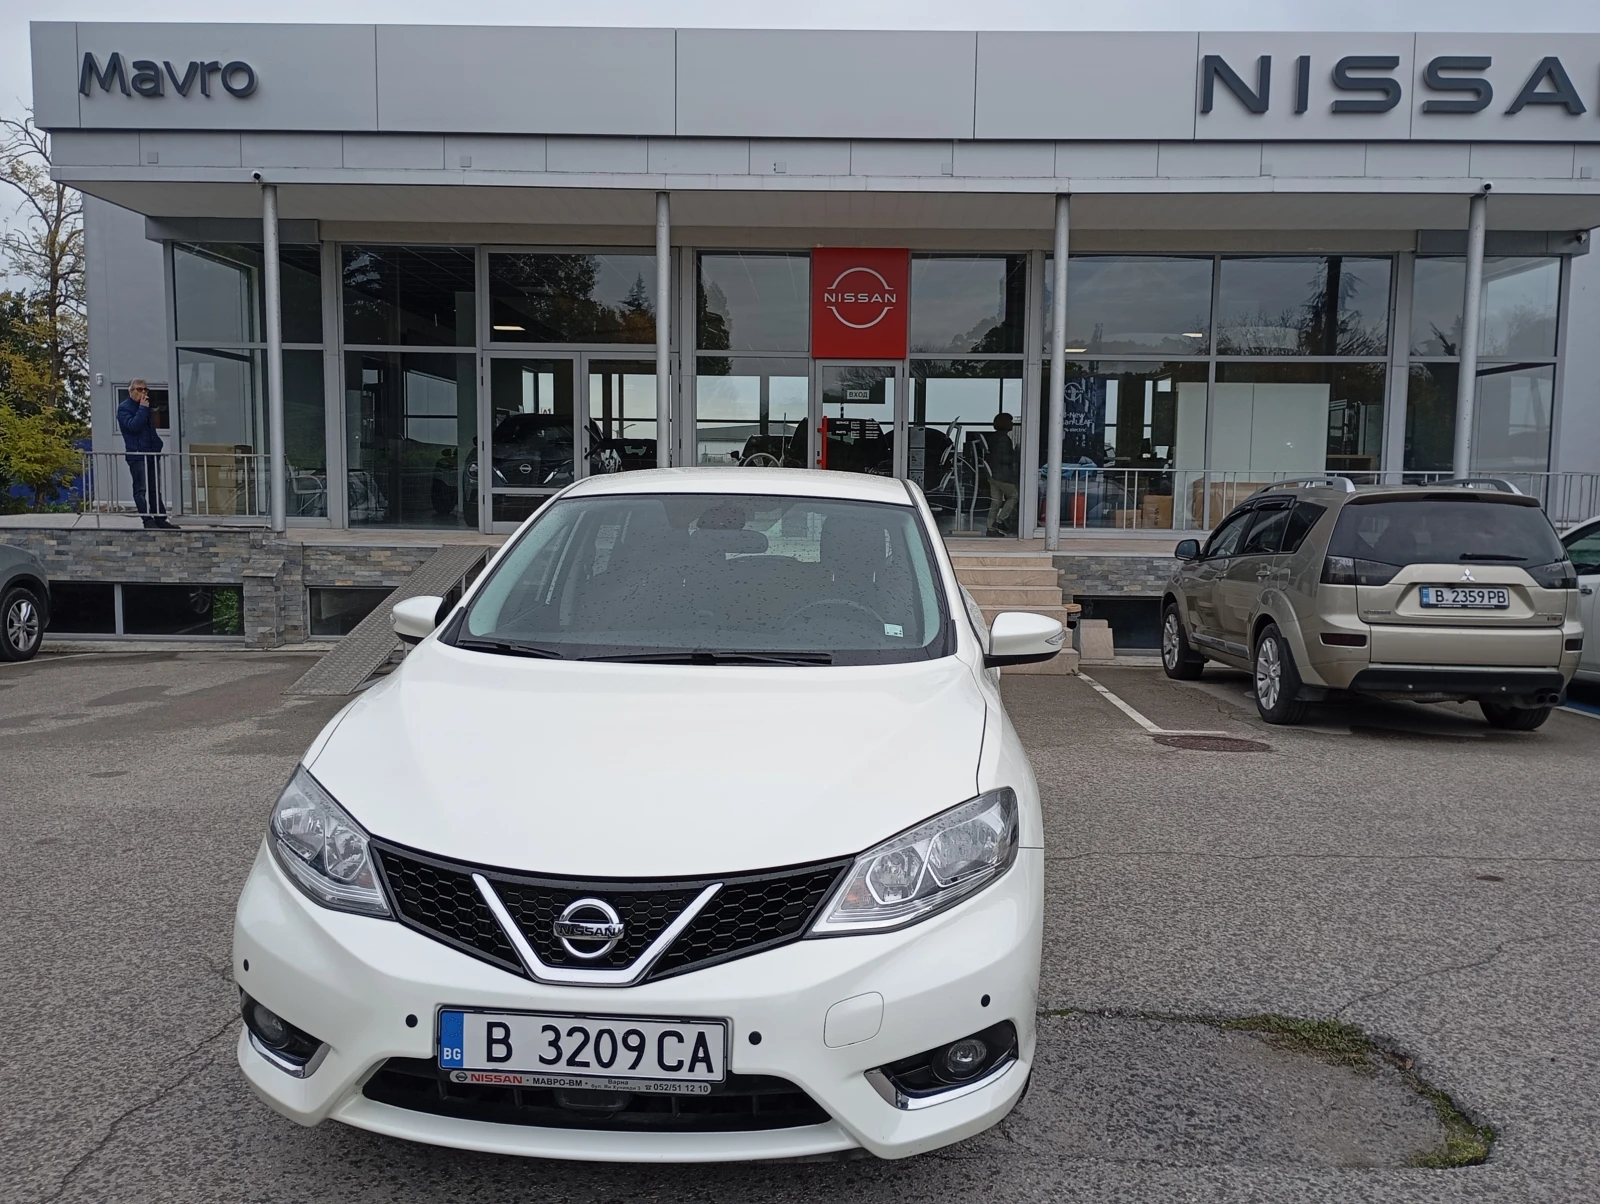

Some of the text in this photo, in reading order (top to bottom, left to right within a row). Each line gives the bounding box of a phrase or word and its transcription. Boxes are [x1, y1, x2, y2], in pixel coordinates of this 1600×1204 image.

[79, 52, 259, 98] Mavro
[1200, 54, 1600, 115] NISSA
[824, 293, 897, 303] NISSAN
[848, 391, 869, 399] ВХОД
[1435, 589, 1445, 603] B
[1451, 590, 1485, 604] 2359
[1487, 590, 1507, 604] PB
[559, 924, 618, 938] NISSAN
[443, 1047, 461, 1060] BG
[485, 1021, 715, 1074] B 3209 CA
[470, 1073, 523, 1084] NISSAN
[532, 1077, 583, 1087] МАВРО-ВМ
[653, 1083, 709, 1093] 052/51 12 10
